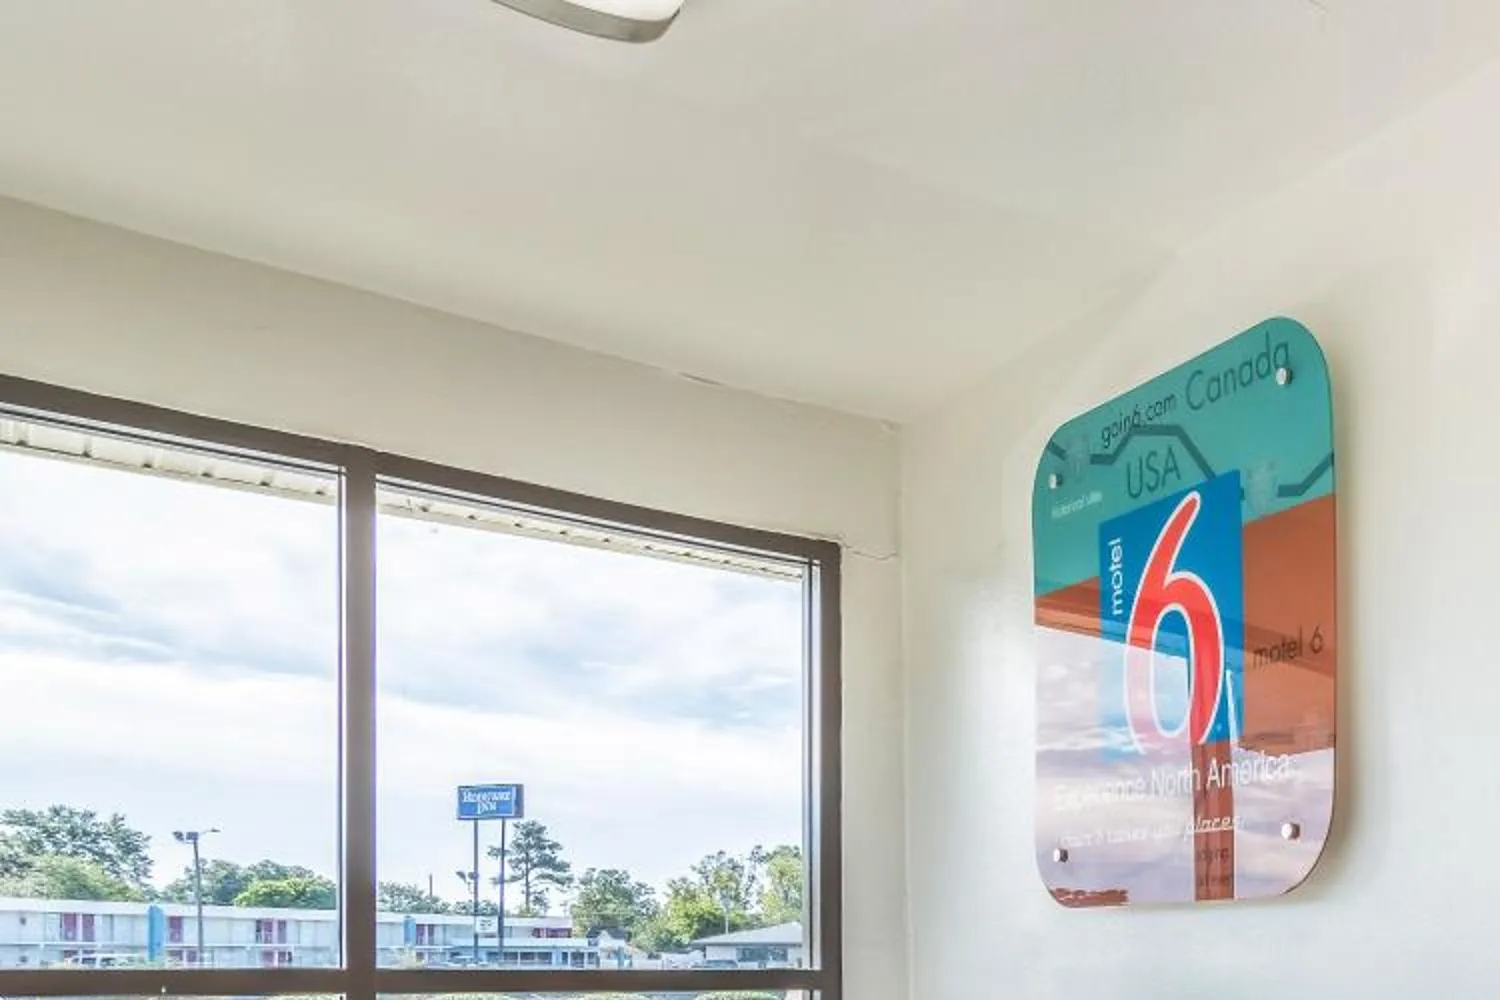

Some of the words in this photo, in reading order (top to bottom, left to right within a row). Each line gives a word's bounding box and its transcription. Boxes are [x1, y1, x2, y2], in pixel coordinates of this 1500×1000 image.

[1185, 331, 1290, 410] Canada
[1126, 445, 1182, 499] USA
[1108, 537, 1123, 615] motel
[1123, 491, 1225, 755] 6
[1253, 623, 1303, 669] motel
[1309, 625, 1323, 655] 6
[1152, 765, 1200, 799] North
